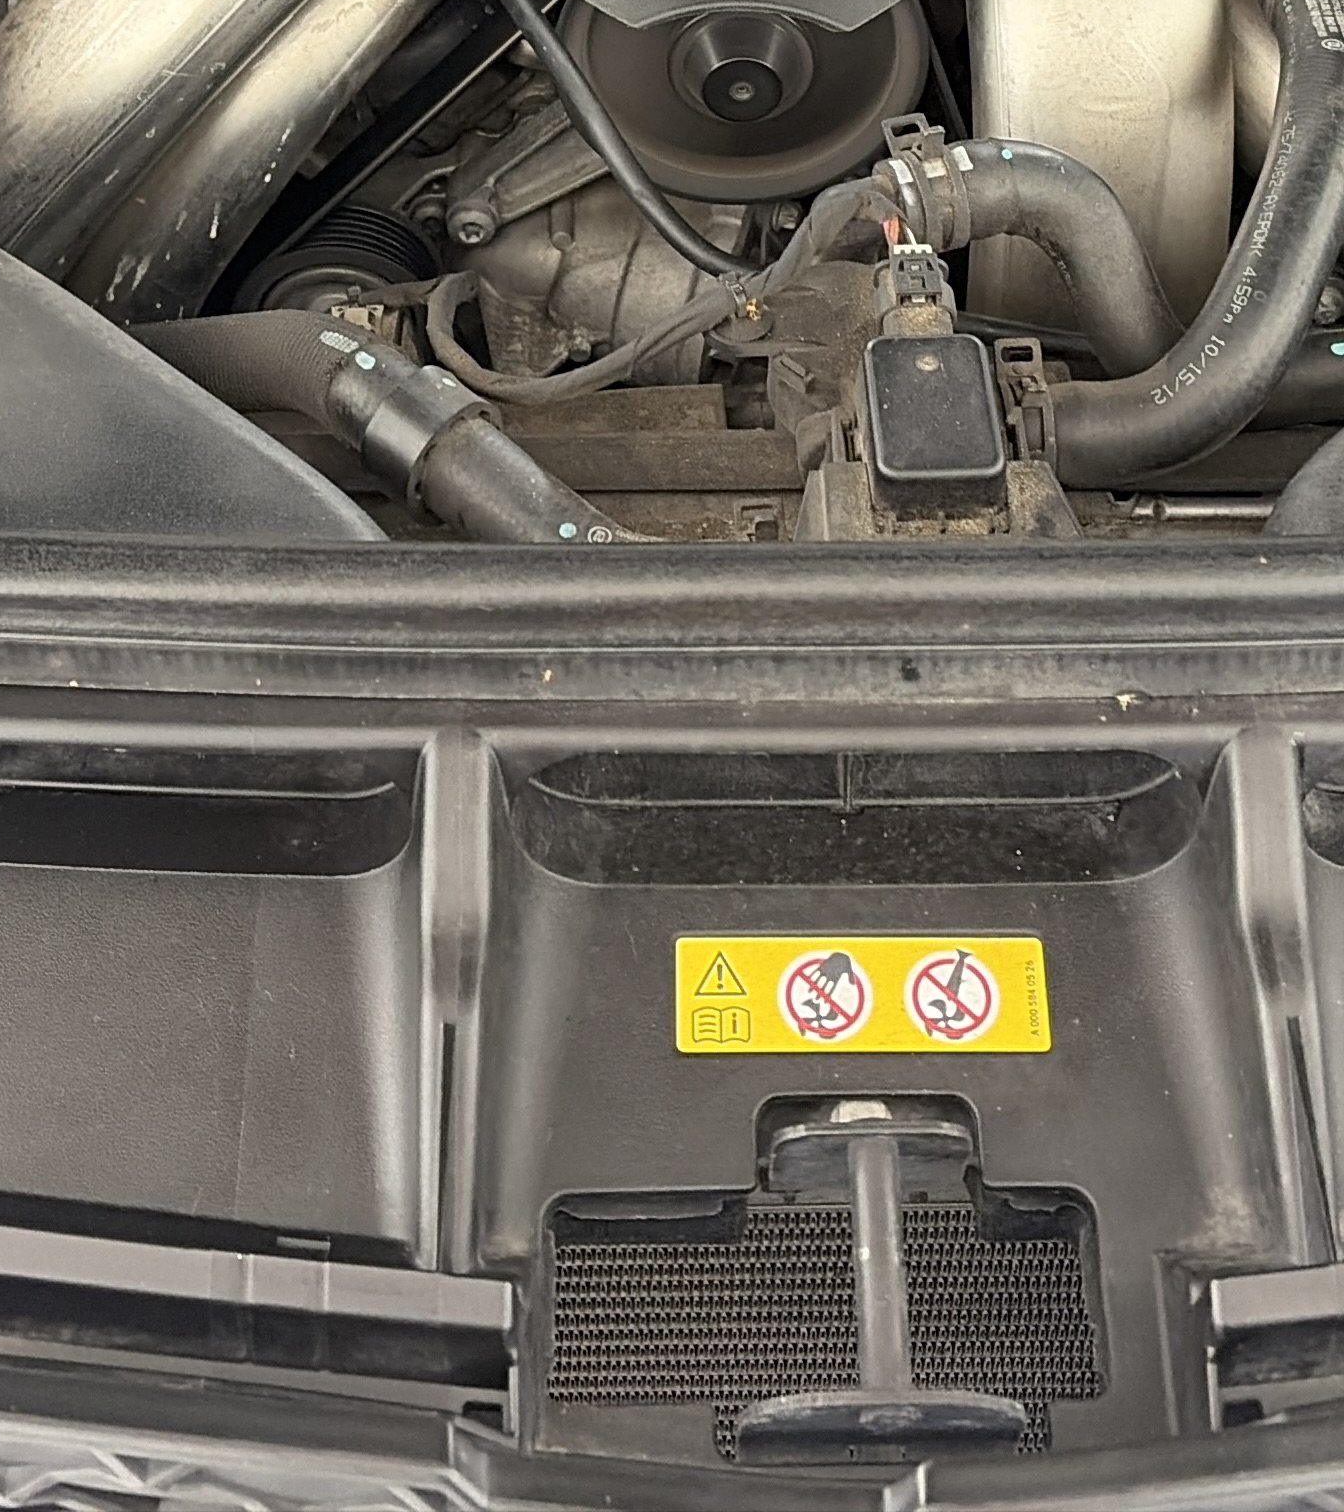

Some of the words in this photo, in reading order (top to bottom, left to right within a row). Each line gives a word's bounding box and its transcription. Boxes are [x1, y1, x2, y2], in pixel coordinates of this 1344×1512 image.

[1150, 335, 1226, 405] 10/15/12
[1025, 960, 1035, 973] 26
[1026, 974, 1036, 987] 05
[1028, 989, 1037, 1007] 584
[1029, 1010, 1040, 1027] 000
